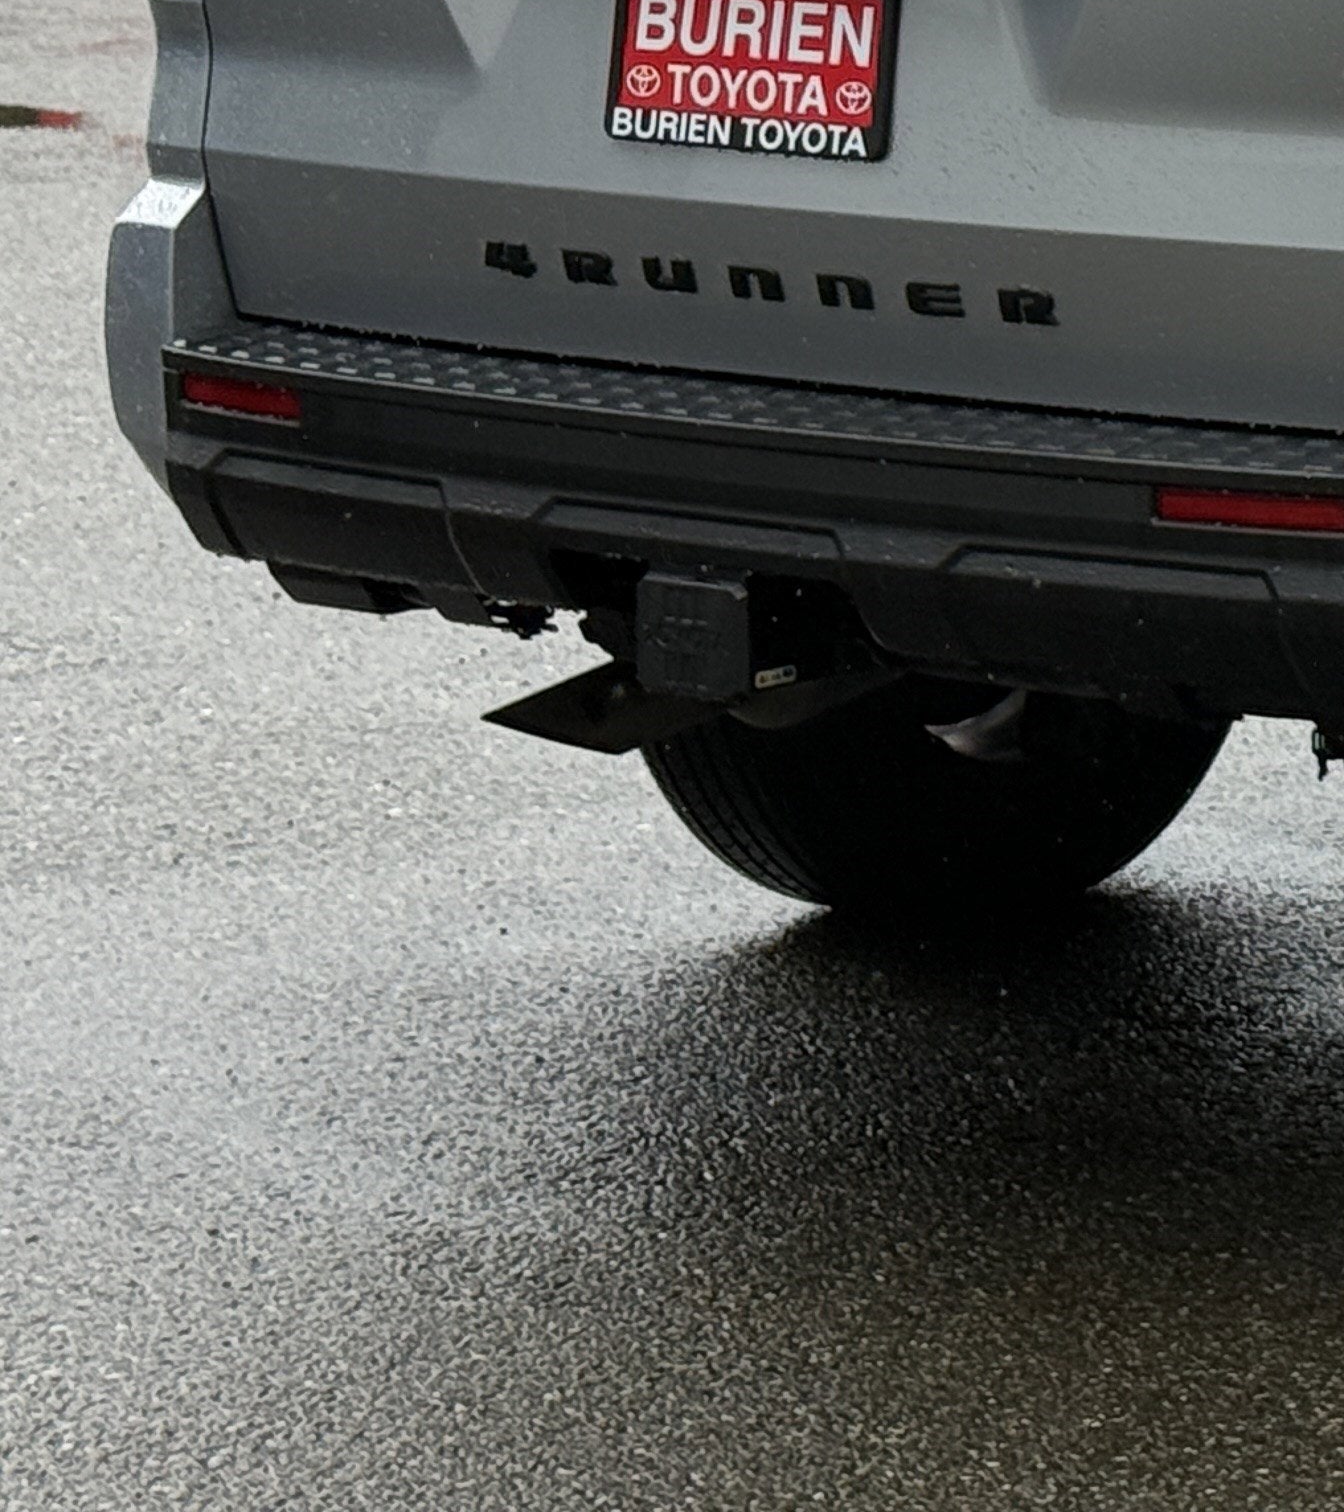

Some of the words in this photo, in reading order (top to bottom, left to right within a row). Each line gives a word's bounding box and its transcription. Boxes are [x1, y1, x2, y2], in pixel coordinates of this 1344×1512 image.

[667, 64, 829, 116] TOYOTA
[611, 106, 732, 145] BURIEN
[741, 117, 868, 157] TOYOTA
